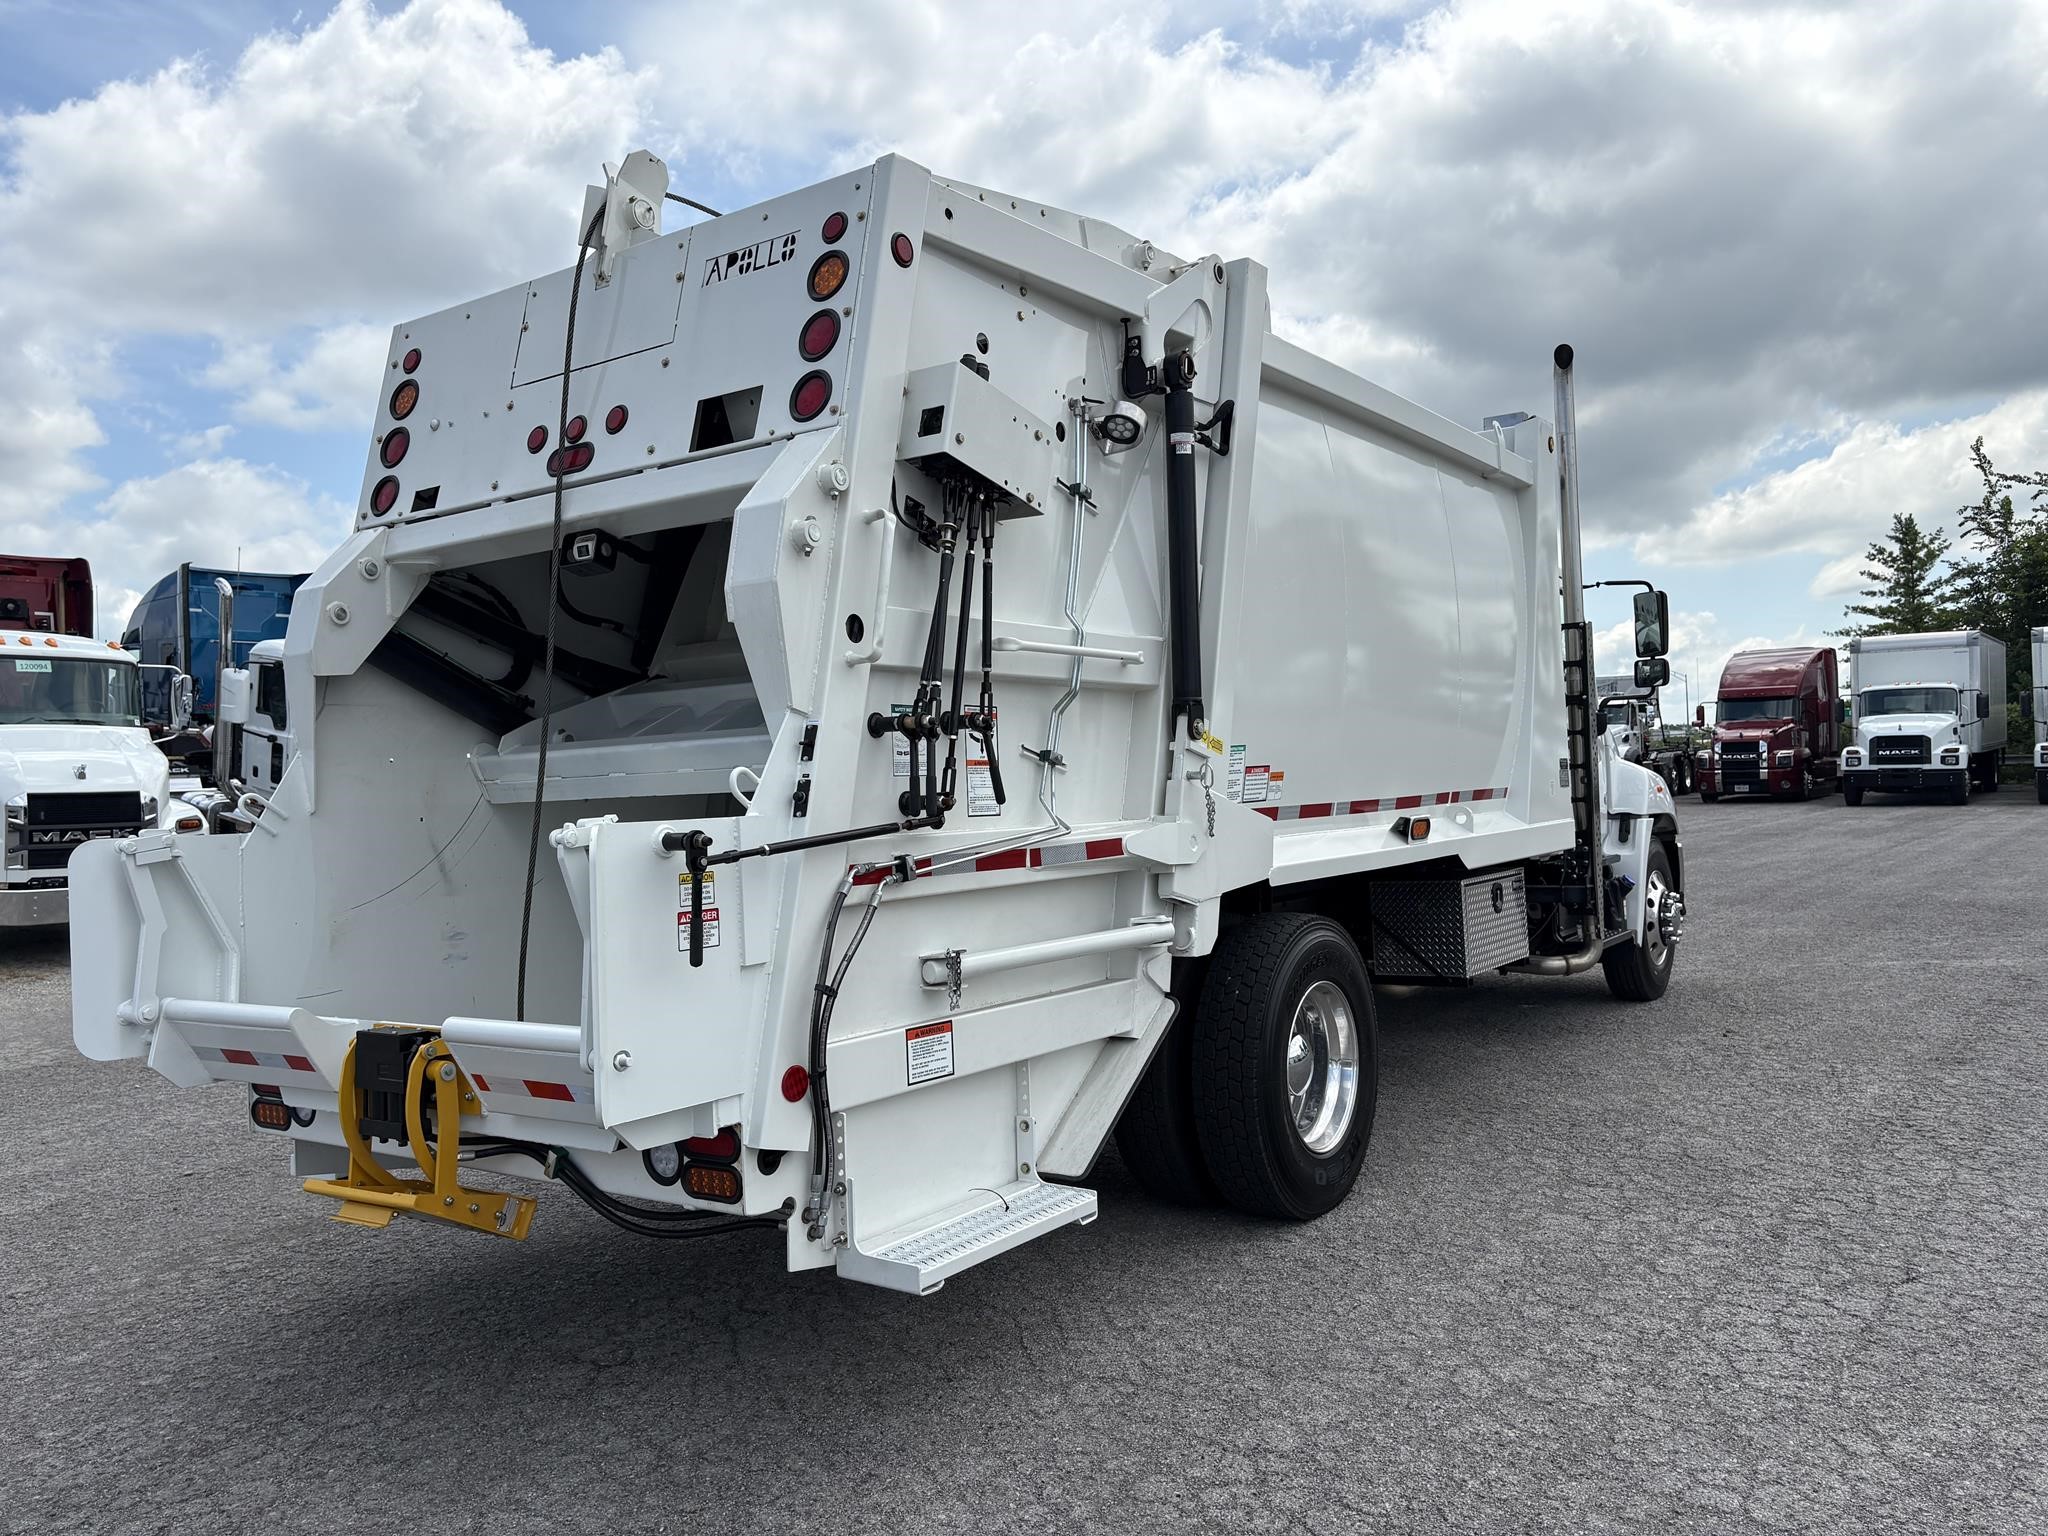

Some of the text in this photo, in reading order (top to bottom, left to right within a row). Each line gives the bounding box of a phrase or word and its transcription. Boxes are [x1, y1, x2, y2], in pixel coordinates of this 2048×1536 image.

[705, 234, 797, 286] APOLLO
[20, 663, 48, 671] 120094
[32, 828, 134, 843] MACK
[687, 910, 717, 922] DGER
[920, 1026, 944, 1036] WARNING
